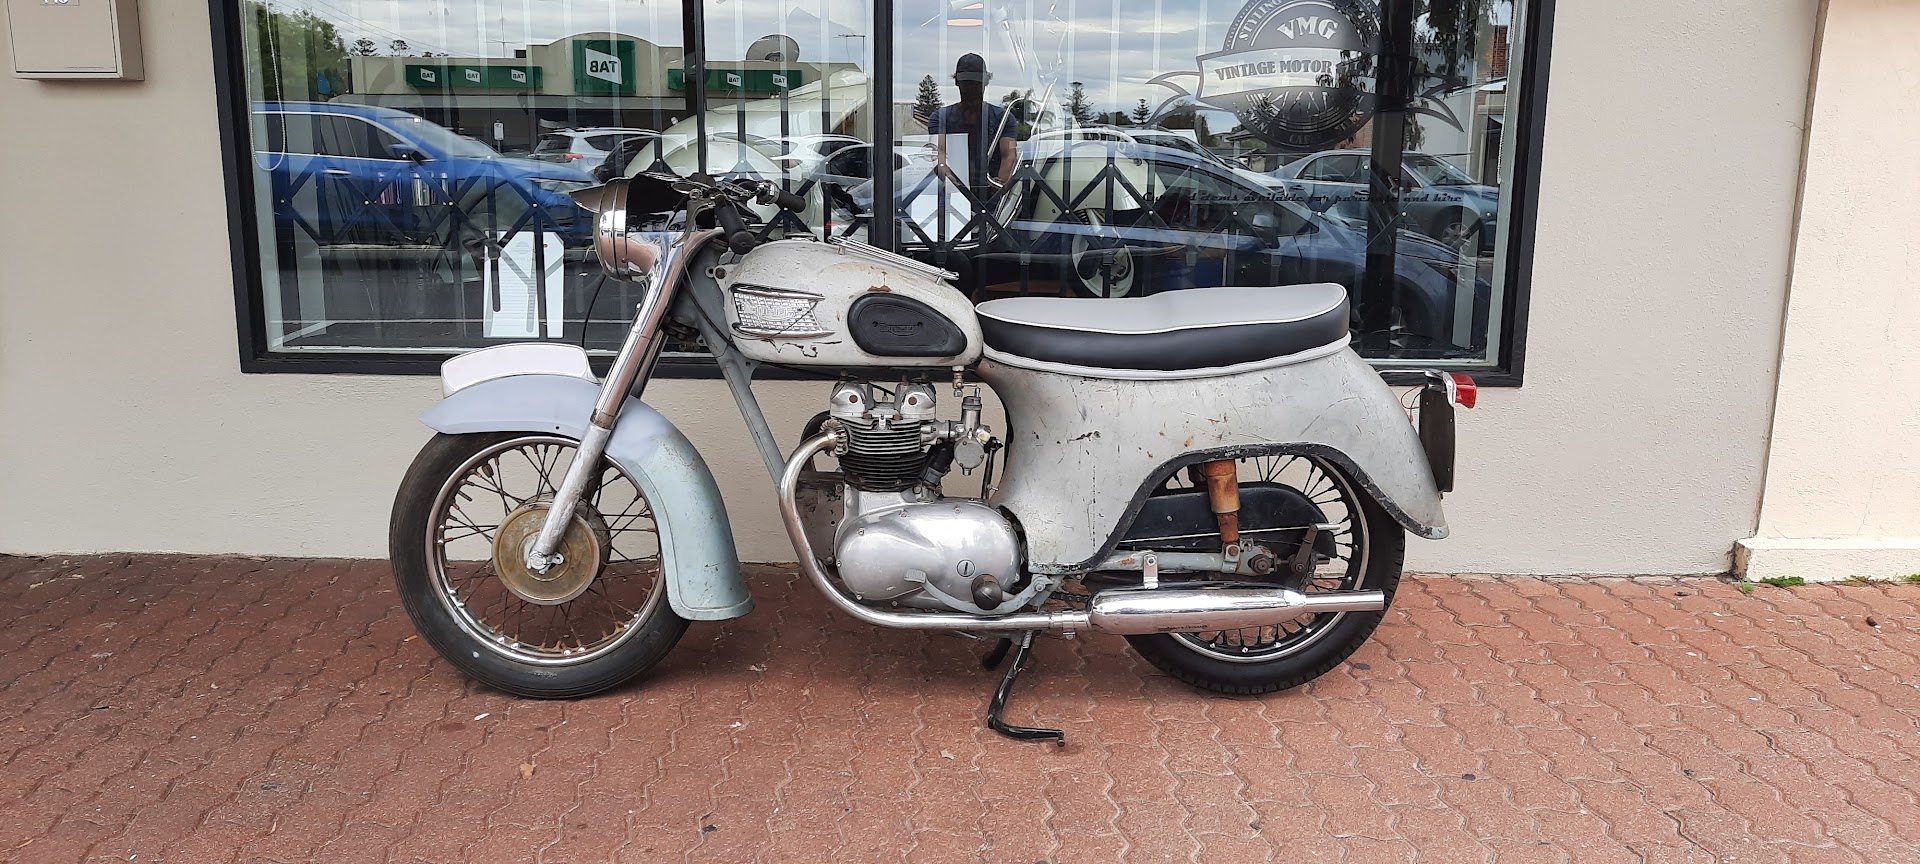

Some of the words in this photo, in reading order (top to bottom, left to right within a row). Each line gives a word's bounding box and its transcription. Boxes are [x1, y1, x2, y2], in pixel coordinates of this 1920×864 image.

[1276, 15, 1338, 40] VMG
[1215, 61, 1277, 81] VINTAGE
[1279, 59, 1333, 74] MOTOR
[1244, 193, 1304, 202] available
[1403, 193, 1430, 202] and
[1433, 193, 1462, 202] hire
